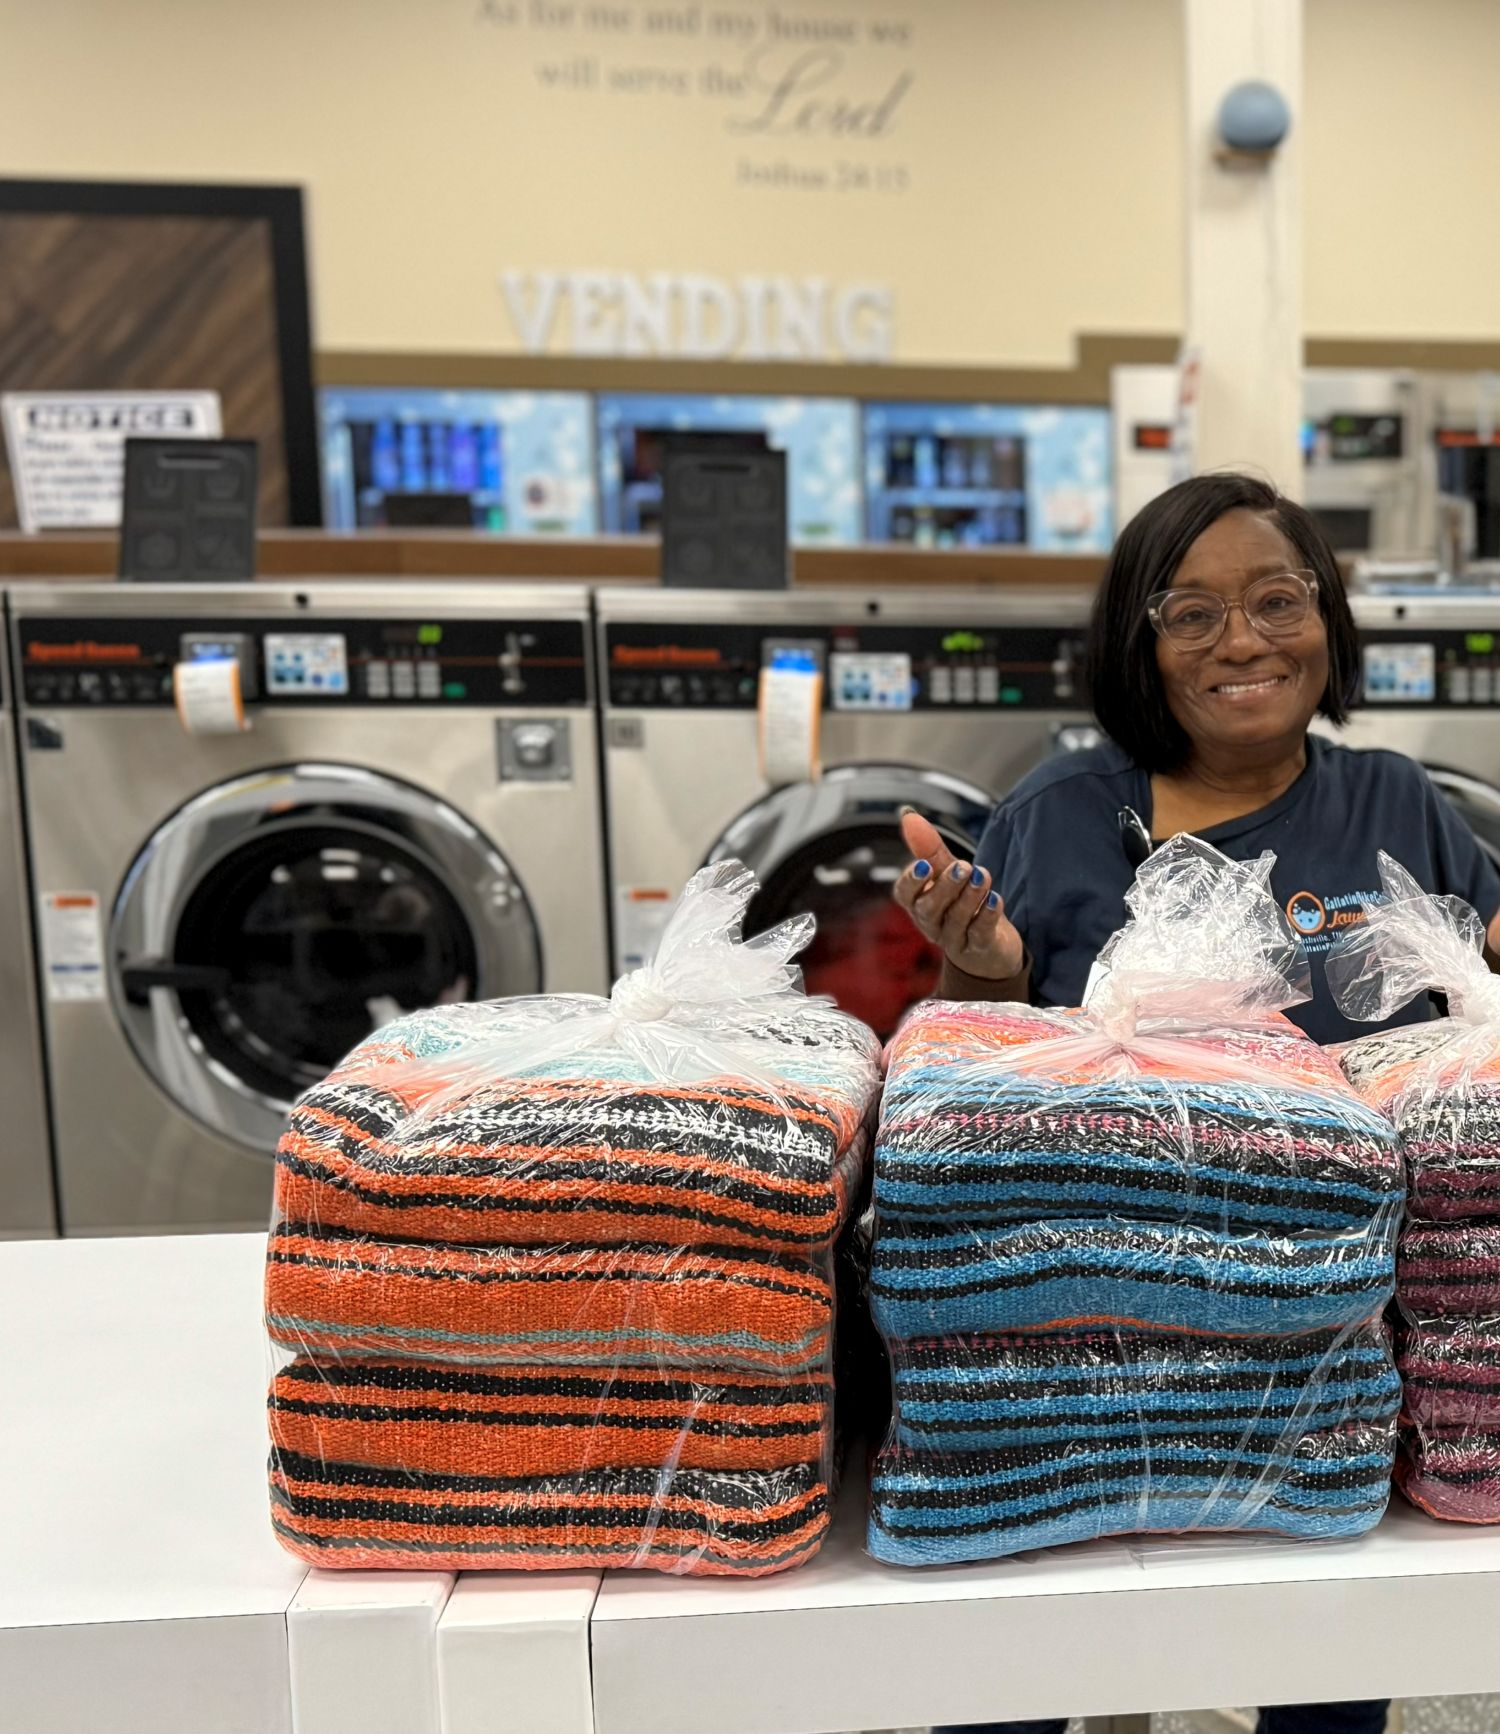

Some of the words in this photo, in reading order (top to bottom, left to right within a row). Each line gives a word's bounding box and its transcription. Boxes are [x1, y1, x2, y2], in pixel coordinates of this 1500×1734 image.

[476, 0, 519, 25] As
[531, 0, 574, 27] for
[587, 7, 629, 30] me
[647, 5, 700, 34] and
[709, 12, 754, 42] my
[764, 6, 854, 41] house
[871, 20, 911, 44] we
[536, 58, 598, 87] will
[608, 68, 689, 95] serve
[699, 64, 744, 94] the
[726, 46, 914, 137] Lord
[499, 271, 894, 365] VENDING
[28, 404, 195, 430] NOTICE
